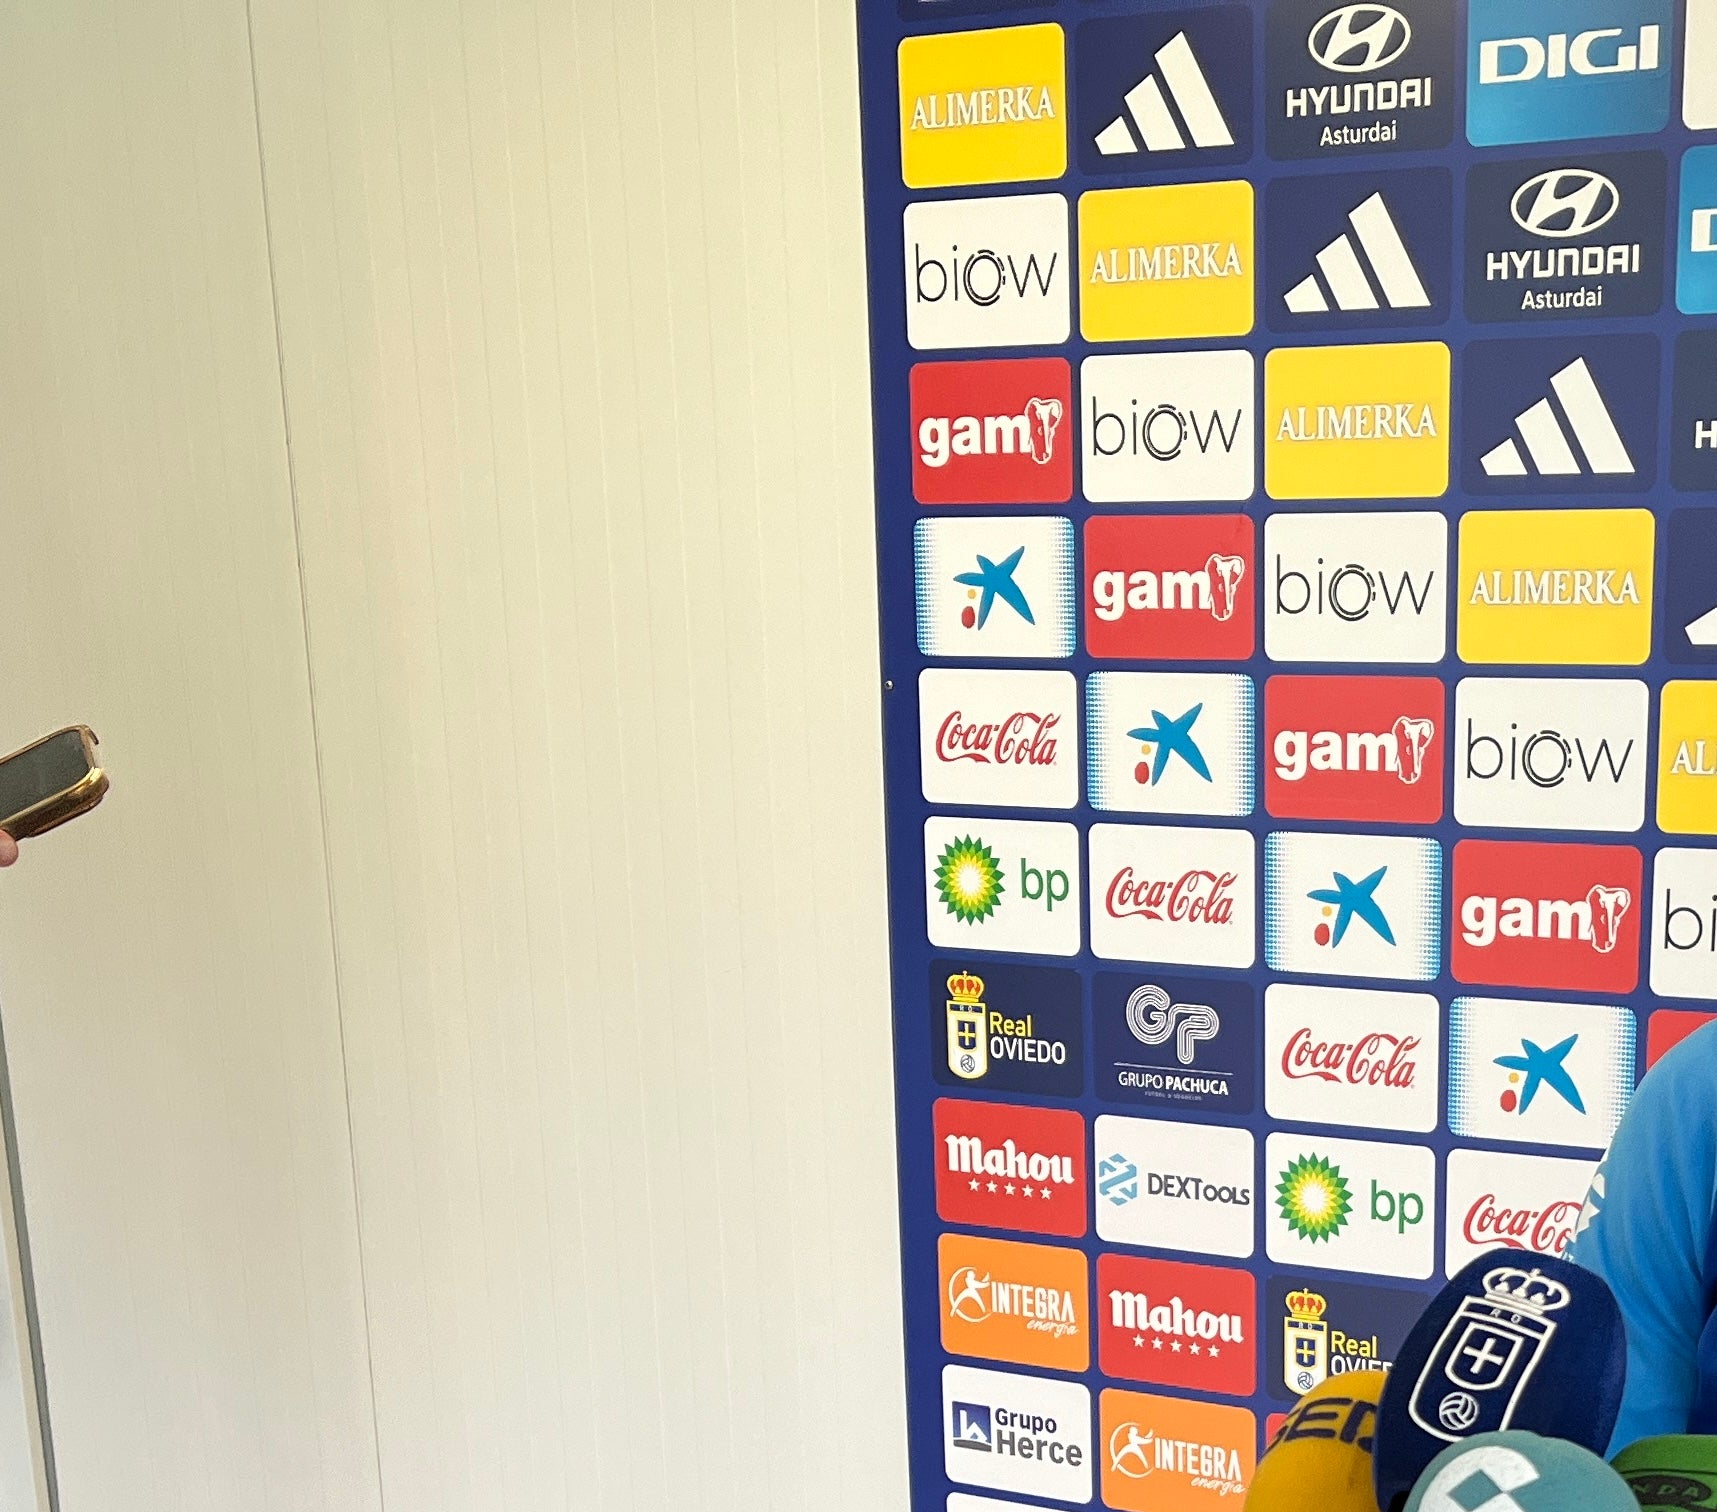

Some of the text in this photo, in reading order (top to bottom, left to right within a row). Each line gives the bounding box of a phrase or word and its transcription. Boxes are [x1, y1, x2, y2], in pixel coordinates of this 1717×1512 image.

[1479, 24, 1660, 84] DIGI
[911, 86, 1055, 131] ALIMERKA
[1286, 77, 1431, 119] HYUNDAI
[1319, 120, 1397, 147] Asturdai
[915, 243, 1057, 306] biow
[1090, 242, 1243, 284] ALIMERKA
[1486, 244, 1640, 281] HYUNDAI
[1521, 286, 1603, 310] Asturdai
[1093, 396, 1242, 461] biow
[1276, 402, 1437, 442] ALIMERKA
[1276, 555, 1434, 621] biow
[1469, 569, 1640, 606] ALIMERKA
[936, 710, 1061, 765] Coca-Cola
[1466, 717, 1634, 788] biow
[1020, 858, 1069, 913] bp
[1105, 867, 1238, 924] Coca-Cola
[989, 1011, 1032, 1037] Real
[990, 1035, 1066, 1065] OVIEDO
[1281, 1027, 1421, 1089] Coca-Cola
[1118, 1071, 1163, 1089] GRUPO
[1165, 1075, 1229, 1096] PACHUCA
[1371, 1180, 1424, 1233] bp
[1463, 1194, 1583, 1253] Coca-Co
[991, 1281, 1074, 1322] INTEGRA
[1331, 1330, 1377, 1359] Real
[995, 1407, 1057, 1435] Grupo
[995, 1431, 1083, 1467] Herce
[1154, 1436, 1241, 1481] INTEGRA
[1633, 1484, 1700, 1498] NDA
